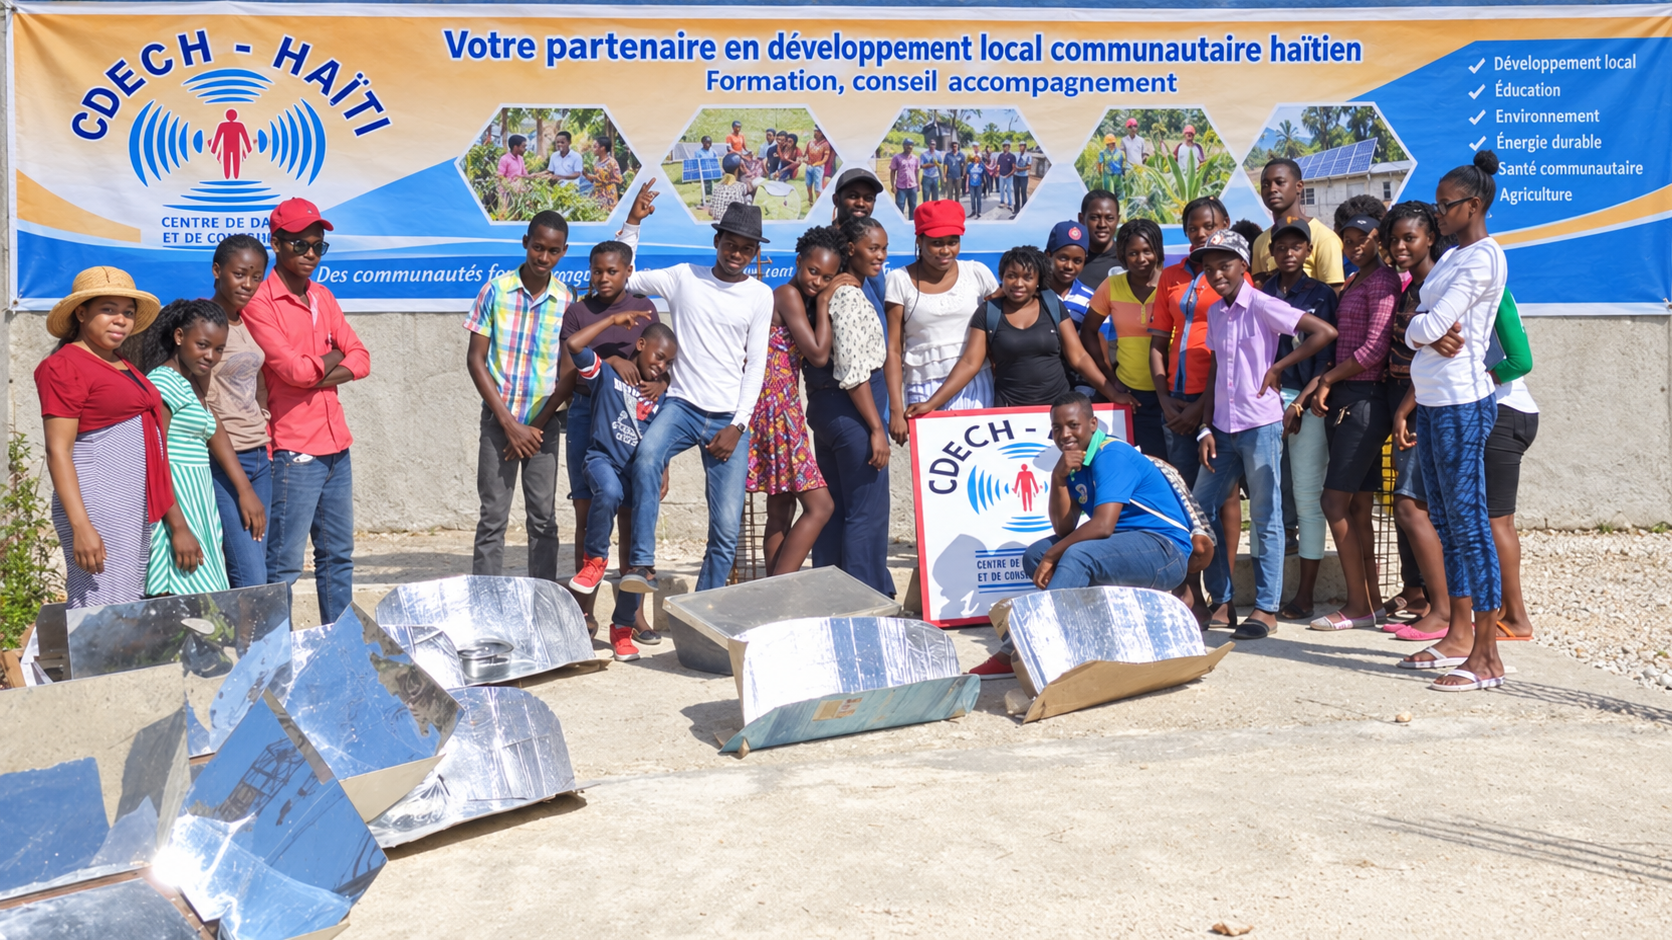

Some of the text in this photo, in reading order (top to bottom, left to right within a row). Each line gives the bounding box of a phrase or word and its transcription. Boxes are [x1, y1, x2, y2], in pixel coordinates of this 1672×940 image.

[444, 30, 1361, 67] Votre partenaire en développement local communautaire haïtien
[1494, 54, 1636, 74] Développement local
[71, 29, 213, 140] CDECH
[273, 35, 392, 137] HAÏTI
[707, 70, 1178, 97] Formation, conseil accompagnement
[1495, 80, 1561, 97] Éducation
[1496, 109, 1600, 123] Environnement
[1496, 132, 1602, 152] Énergie durable
[1498, 161, 1644, 176] Santé communautaire
[1500, 187, 1573, 204] Agriculture
[161, 217, 219, 228] CENTRE
[225, 217, 245, 228] DE
[163, 232, 180, 243] ET
[185, 232, 202, 243] DE
[317, 266, 348, 283] Des
[353, 264, 482, 283] communautés
[928, 420, 1015, 494] CDECH
[976, 558, 1020, 569] CENTRE DE
[978, 573, 987, 582] ET
[991, 572, 1001, 581] DE
